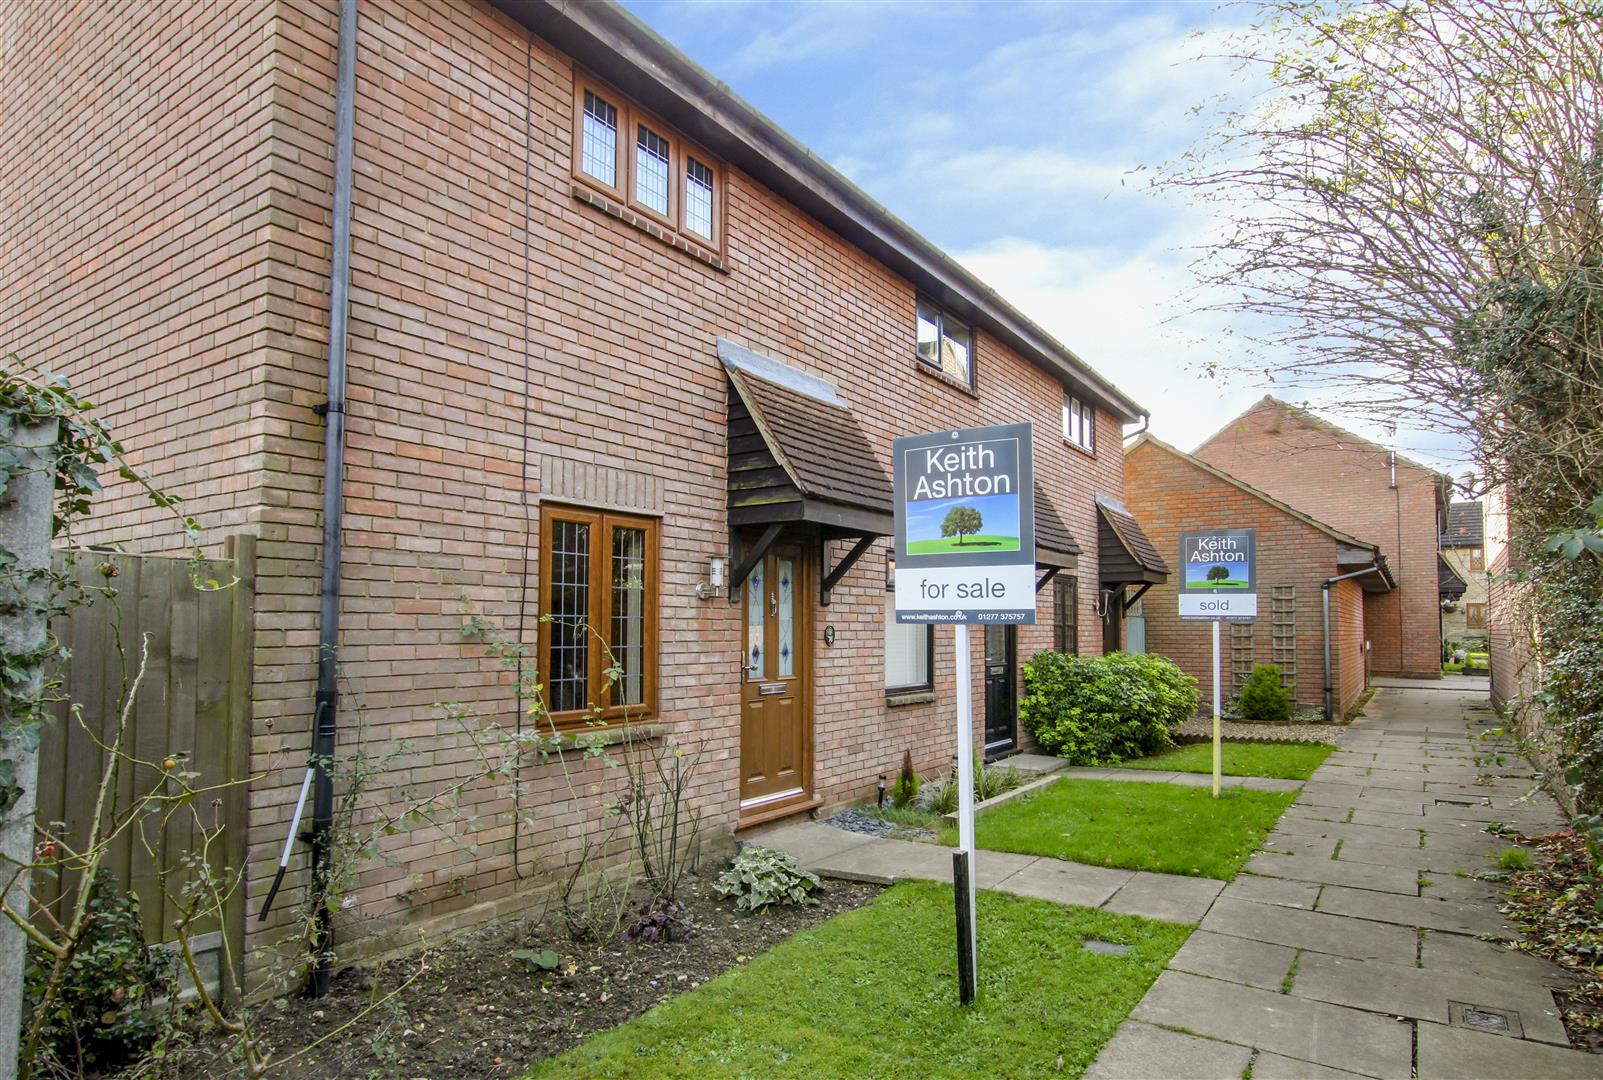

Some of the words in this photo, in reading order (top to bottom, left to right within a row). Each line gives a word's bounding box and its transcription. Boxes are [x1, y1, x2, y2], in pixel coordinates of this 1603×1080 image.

[926, 444, 995, 474] Keith
[913, 472, 1010, 500] Ashton
[1198, 537, 1237, 550] Keith
[1190, 550, 1245, 562] Ashton
[920, 579, 949, 599] for
[956, 577, 1006, 599] sale
